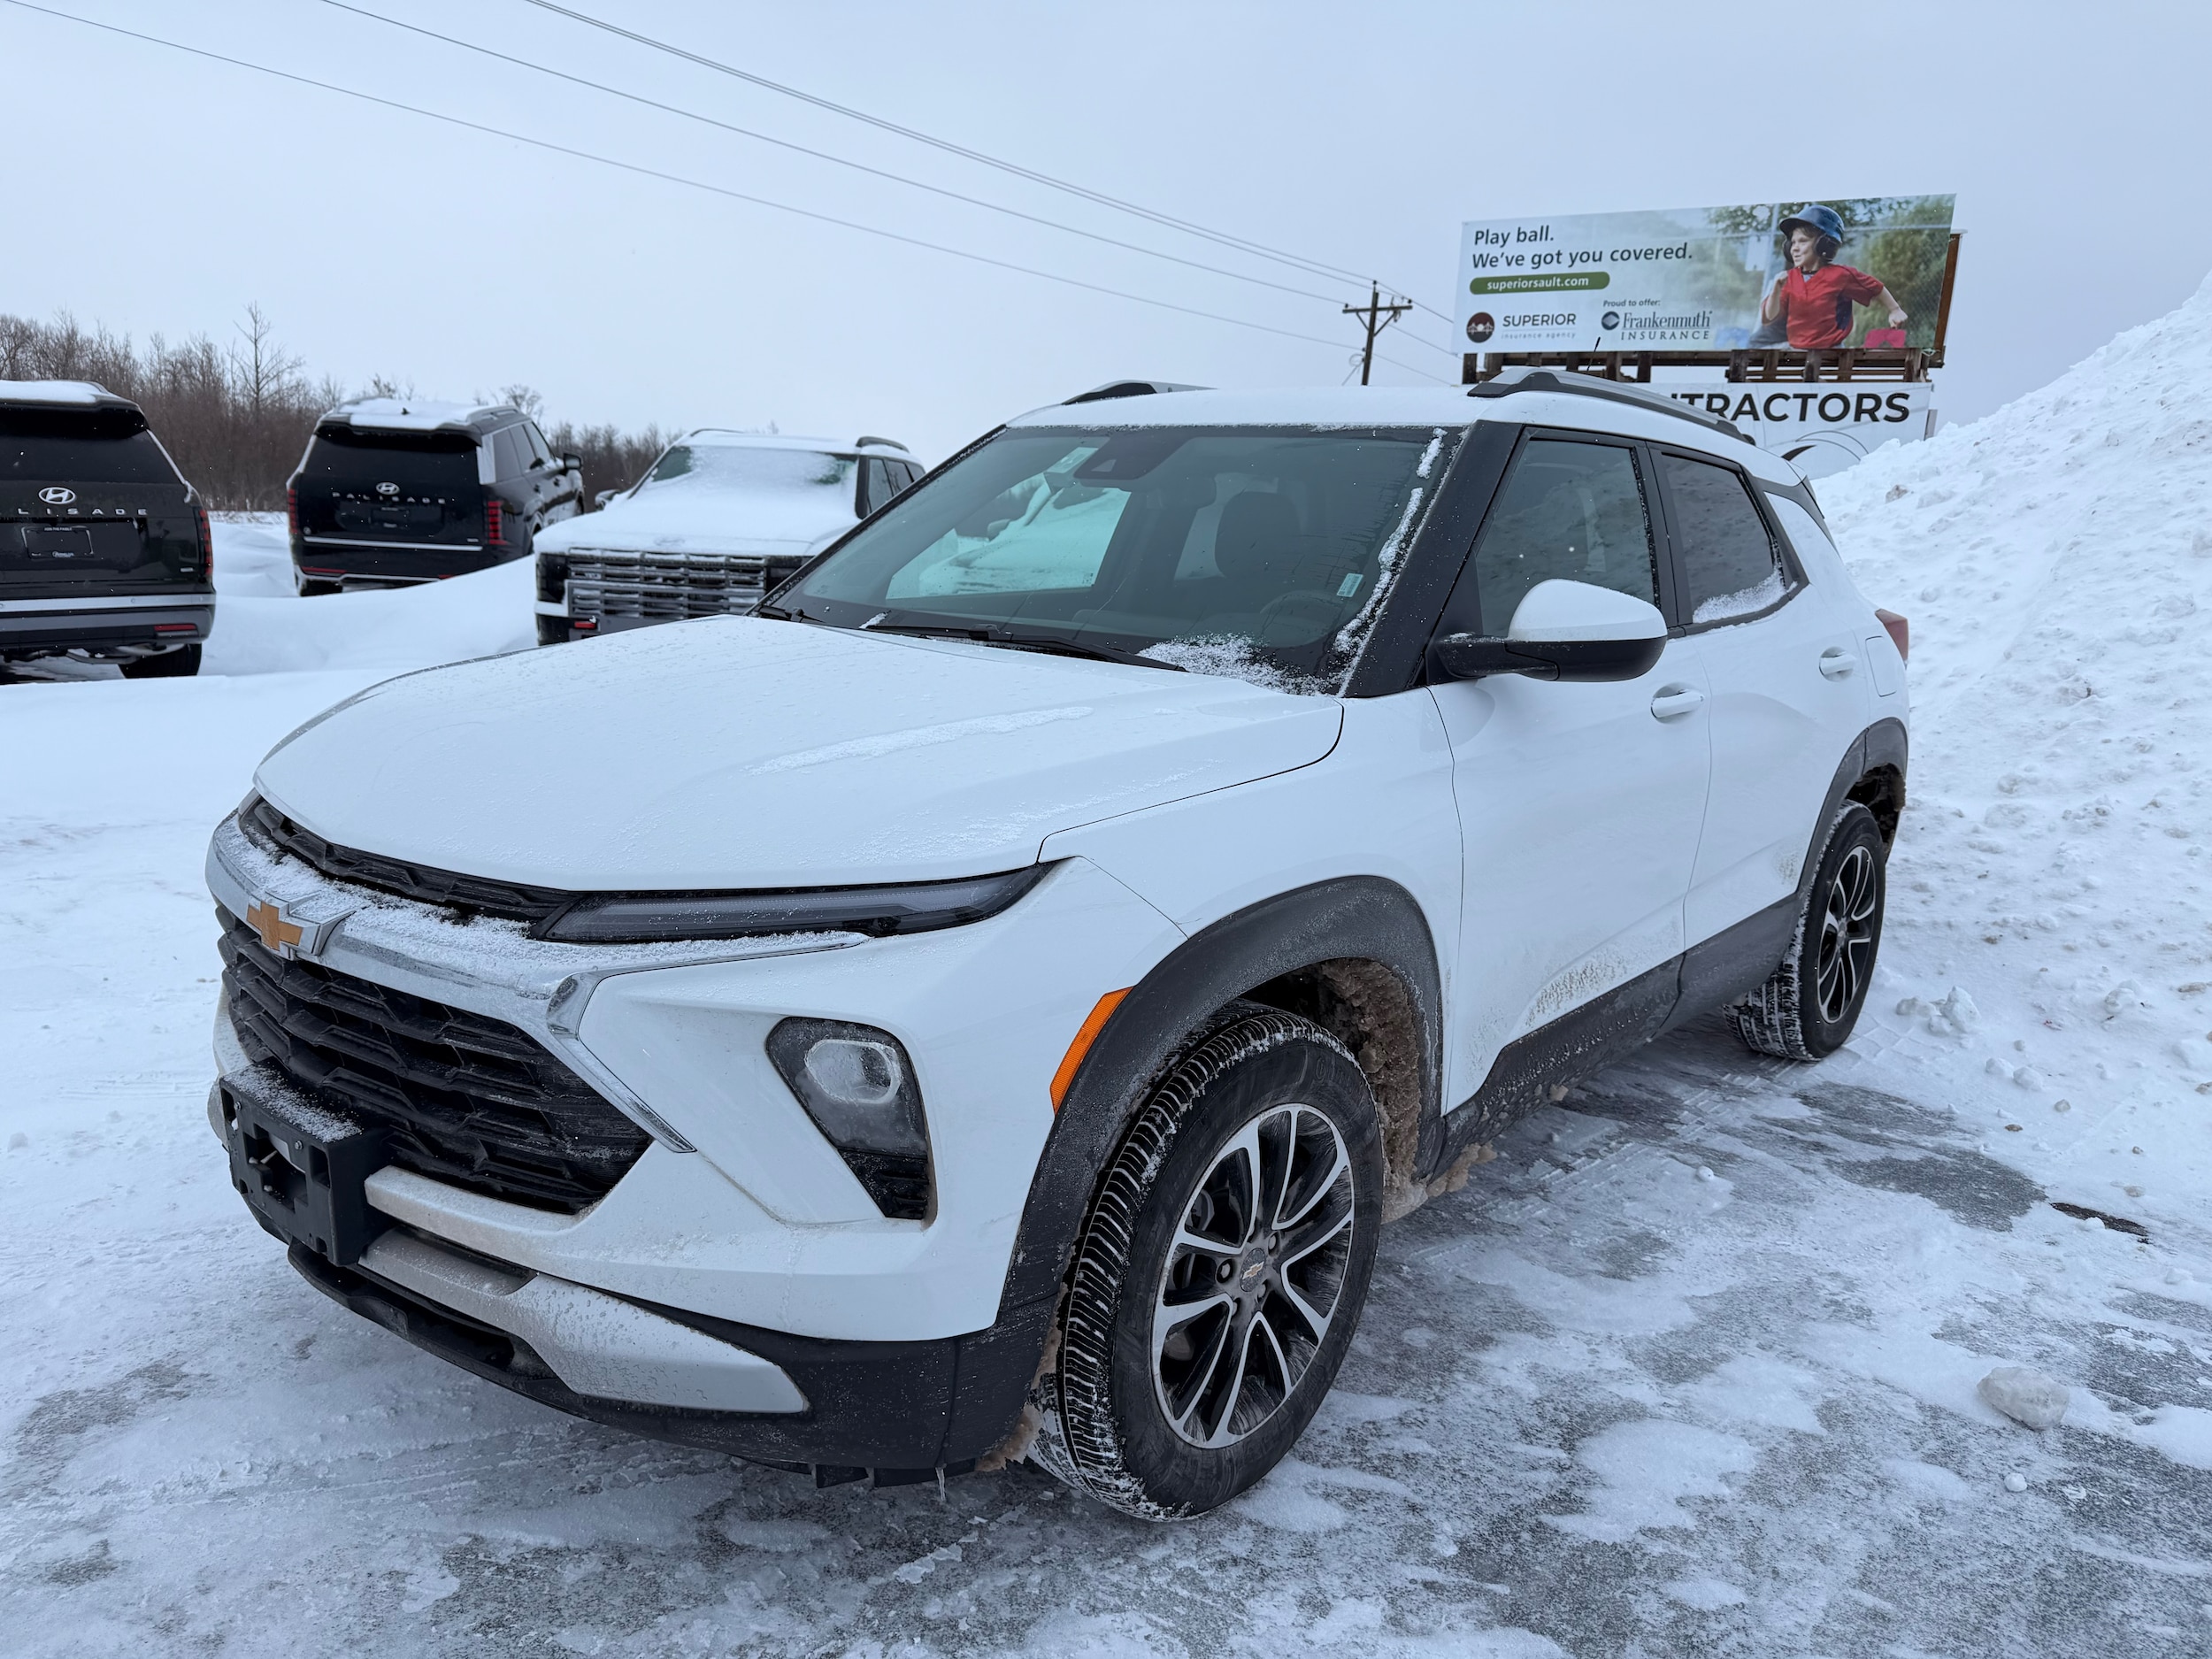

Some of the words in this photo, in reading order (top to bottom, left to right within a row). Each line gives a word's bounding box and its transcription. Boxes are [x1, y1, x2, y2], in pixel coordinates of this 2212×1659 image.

[1474, 228, 1510, 248] Play
[1517, 225, 1554, 243] ball.
[1472, 252, 1525, 269] We've
[1531, 250, 1563, 270] got
[1568, 250, 1602, 268] you
[1610, 242, 1693, 262] covered.
[1487, 276, 1589, 291] superiorsault.com
[1502, 313, 1577, 327] SUPERIOR
[1623, 311, 1710, 328] Frankenmuth
[1621, 330, 1709, 340] INSURANCE
[1671, 393, 1910, 422] TRACTORS
